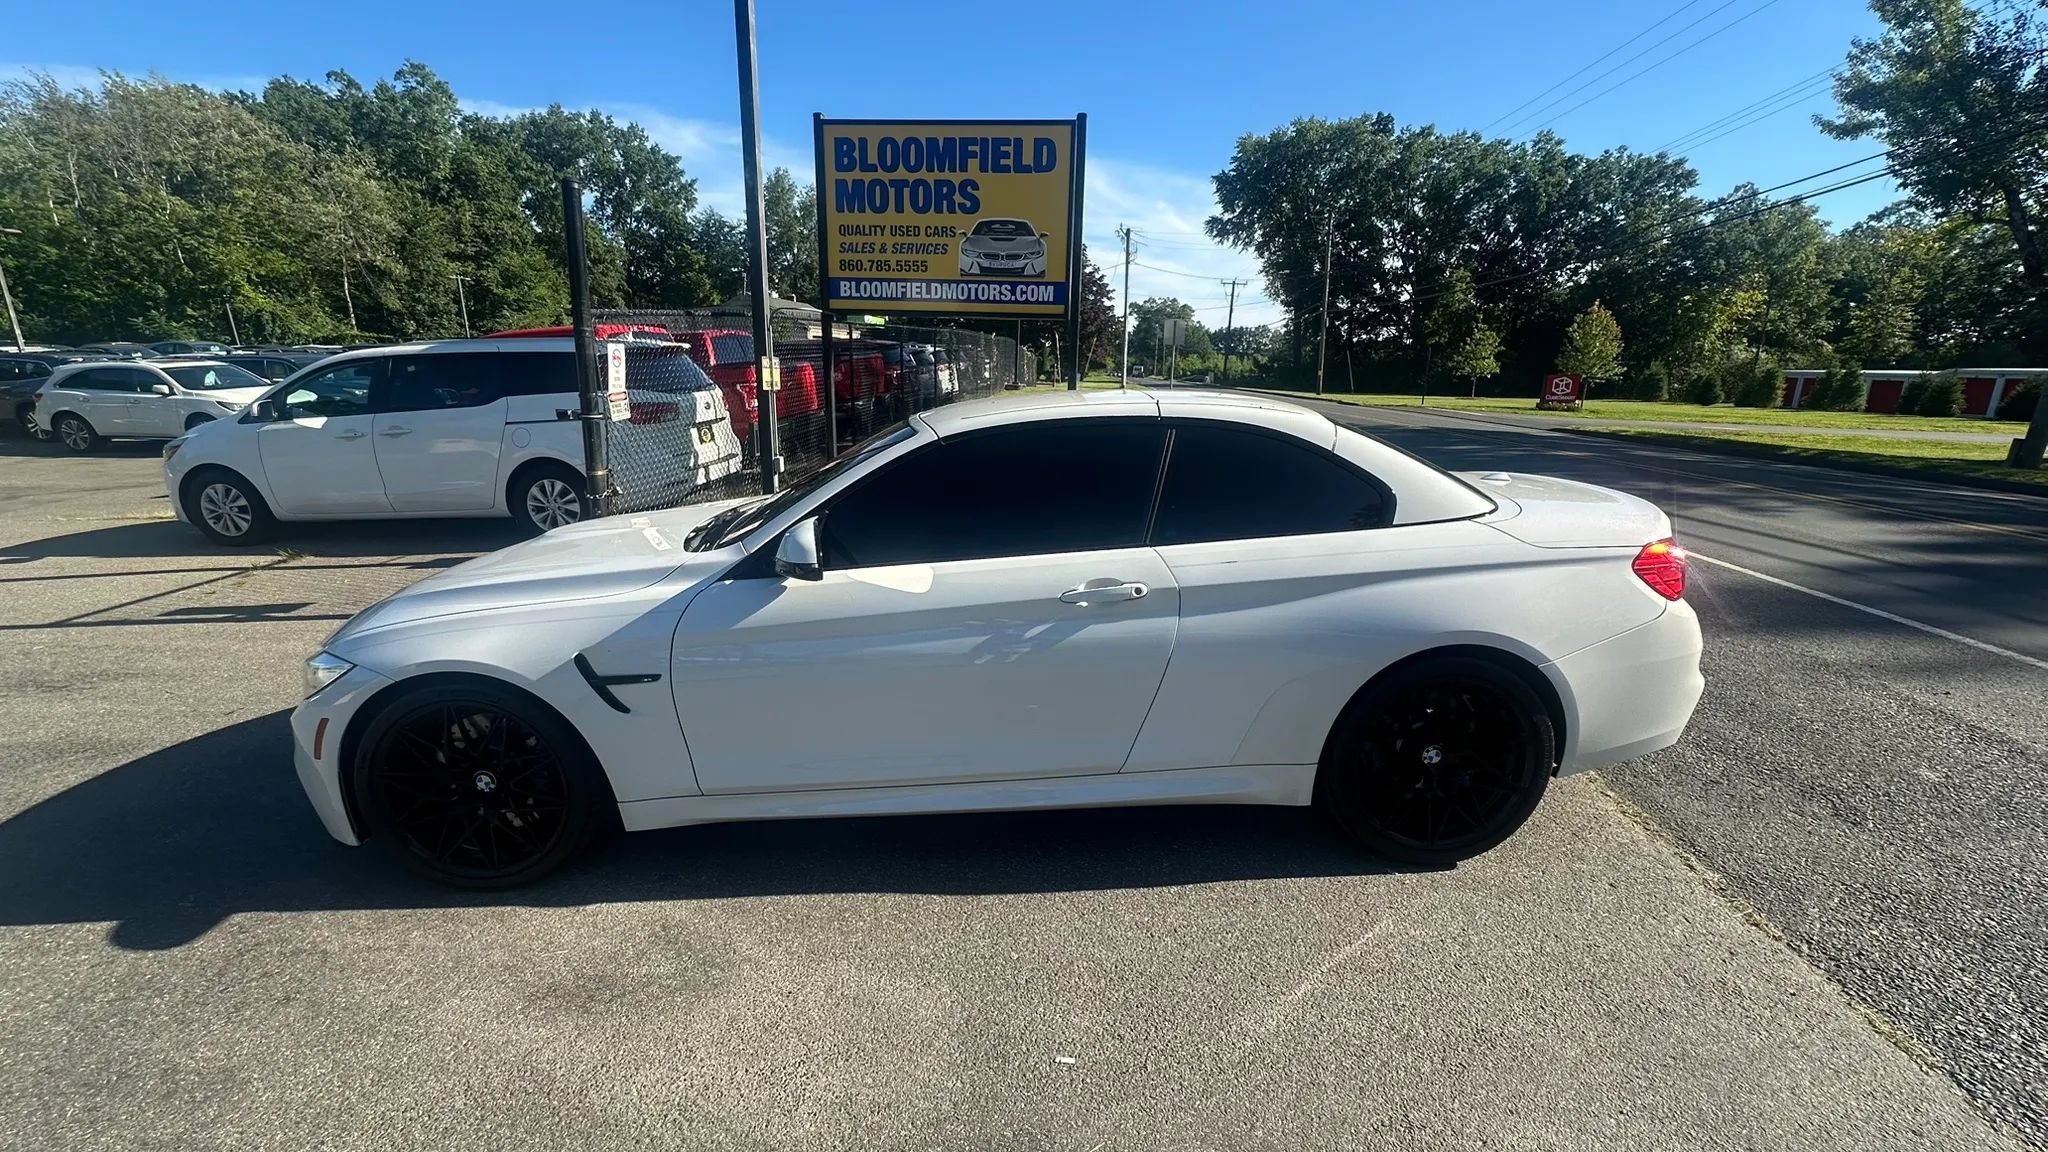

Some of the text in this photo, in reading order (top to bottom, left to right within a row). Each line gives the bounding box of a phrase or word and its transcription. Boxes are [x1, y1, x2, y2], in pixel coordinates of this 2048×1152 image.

[834, 137, 1057, 174] BLOOMFIELD
[834, 178, 981, 214] MOTORS
[838, 224, 957, 238] QUALITY USED CARS
[838, 242, 949, 255] SALES & SERVICES
[838, 259, 928, 273] 860.785.5555
[839, 280, 1055, 302] BLOOMFIELDMOTORS.COM
